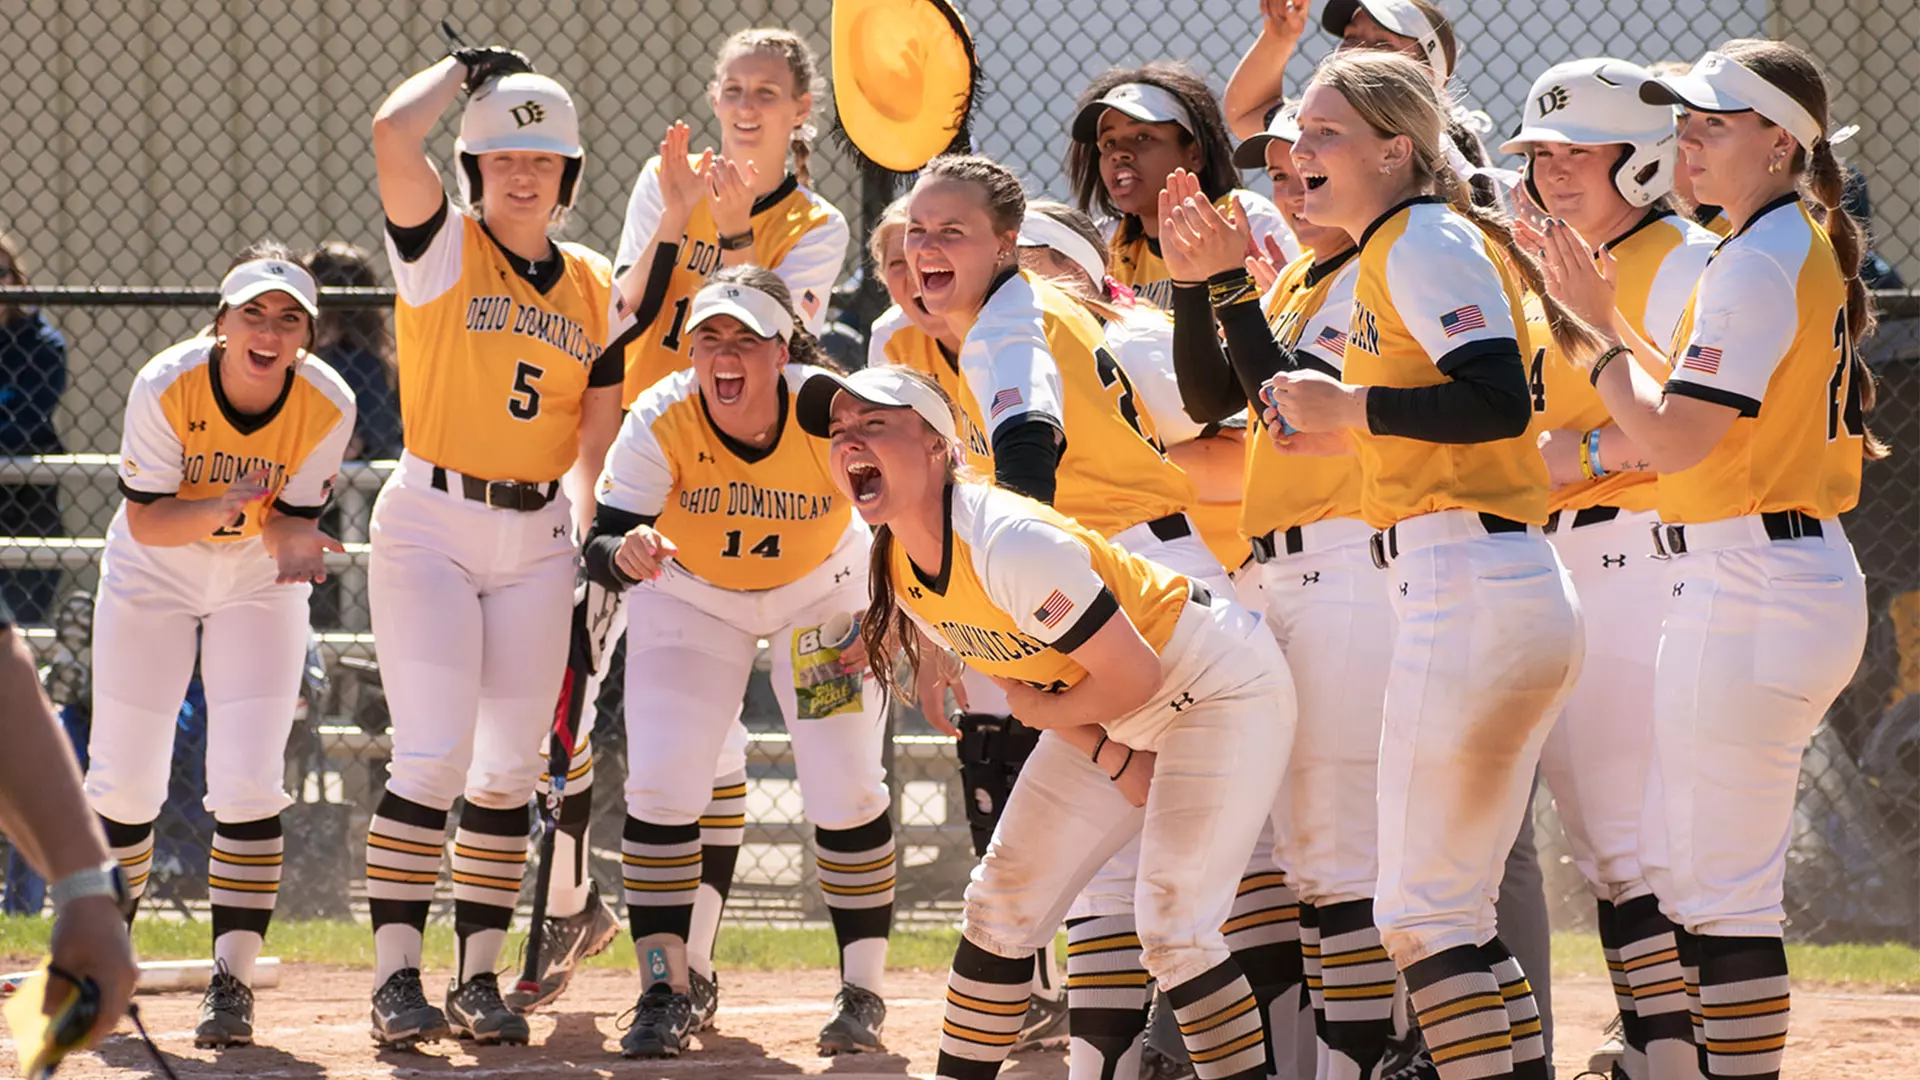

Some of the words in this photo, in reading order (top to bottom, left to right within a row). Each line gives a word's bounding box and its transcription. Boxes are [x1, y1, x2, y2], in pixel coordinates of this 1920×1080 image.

[466, 296, 512, 331] OHIO
[661, 296, 695, 358] 1
[507, 359, 546, 421] 5
[1092, 345, 1169, 463] 2
[181, 454, 204, 485] IO
[679, 486, 721, 514] OHIO
[727, 481, 832, 520] DOMINICAN
[721, 530, 781, 558] 14
